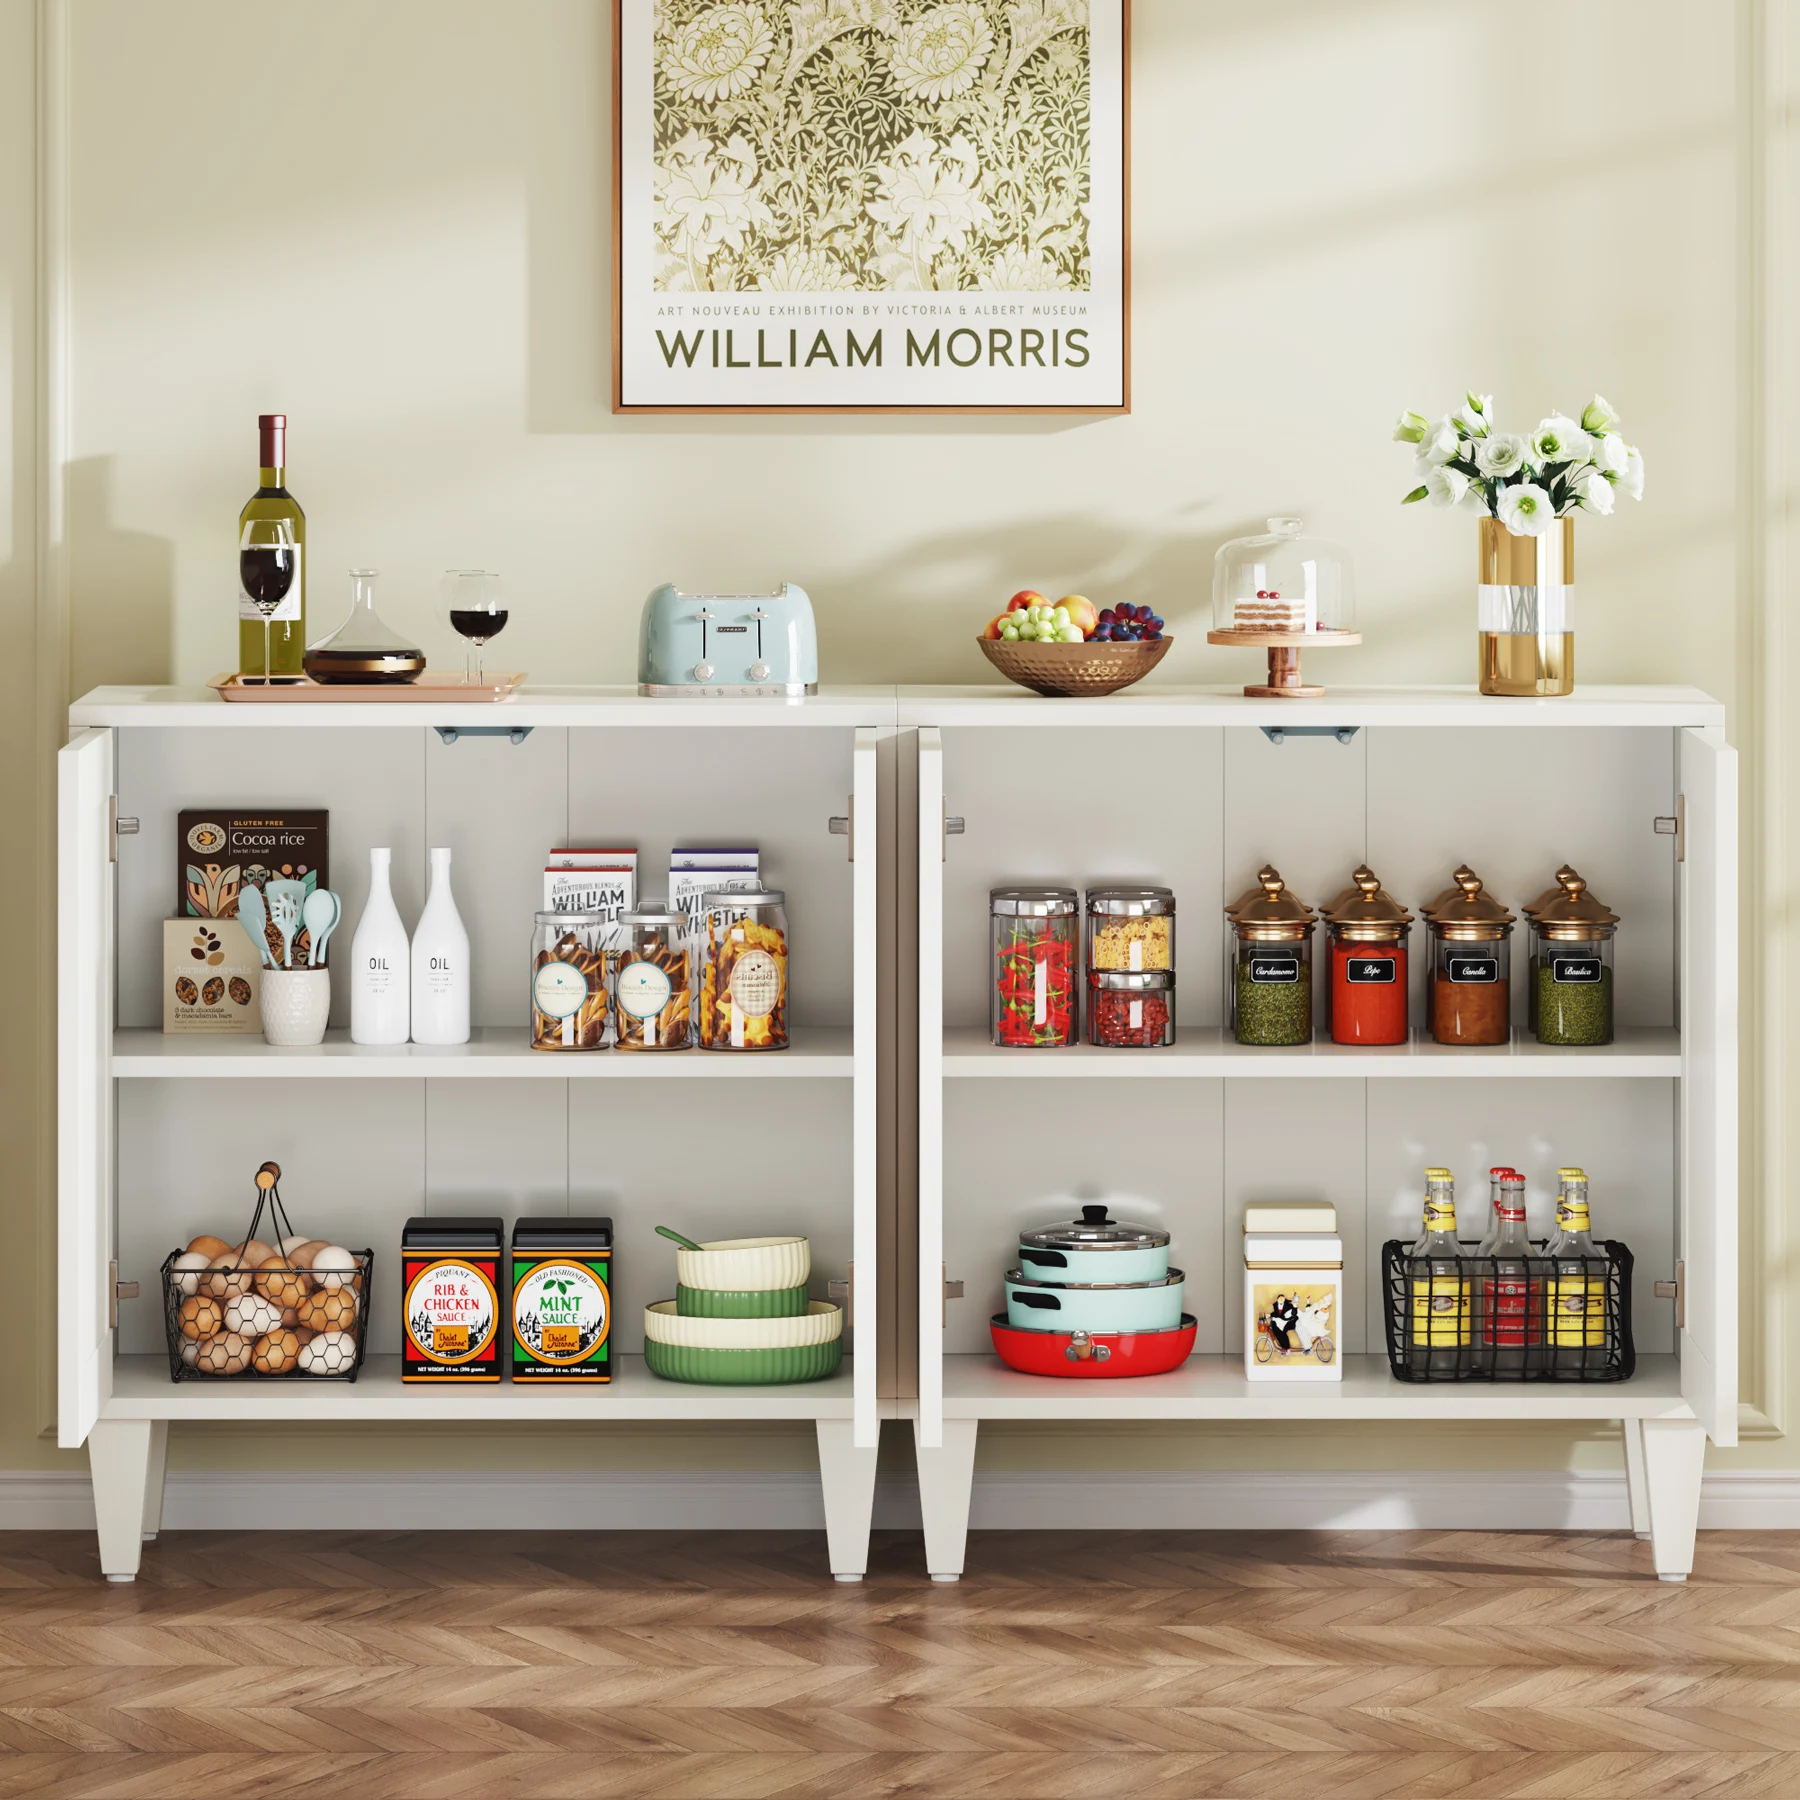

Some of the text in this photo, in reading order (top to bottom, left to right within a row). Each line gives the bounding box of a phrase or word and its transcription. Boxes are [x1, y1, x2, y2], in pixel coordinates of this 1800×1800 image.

[657, 305, 1088, 316] ART NOUVEAU EXHIBITION BY VICTORIA & ALBERT MUSEUM
[655, 328, 1090, 368] WILLIAM MORRIS
[232, 831, 305, 846] Cocoa rice
[191, 842, 223, 852] ORGANIC
[552, 883, 593, 896] ADVENTUROUS
[594, 881, 615, 889] BLENDS
[552, 889, 624, 911] WILLIAM
[369, 957, 389, 970] OIL
[430, 957, 450, 970] OIL
[1255, 966, 1295, 976] Cardamomo
[1363, 964, 1381, 977] Pepe
[435, 1268, 471, 1279] PIQUANT
[535, 1268, 588, 1284] OLD FASHIONED
[434, 1283, 469, 1296] RIB &
[423, 1298, 480, 1311] CHICKEN
[539, 1296, 583, 1312] MINT
[437, 1312, 467, 1322] SAUCE
[542, 1313, 579, 1324] SAUCE
